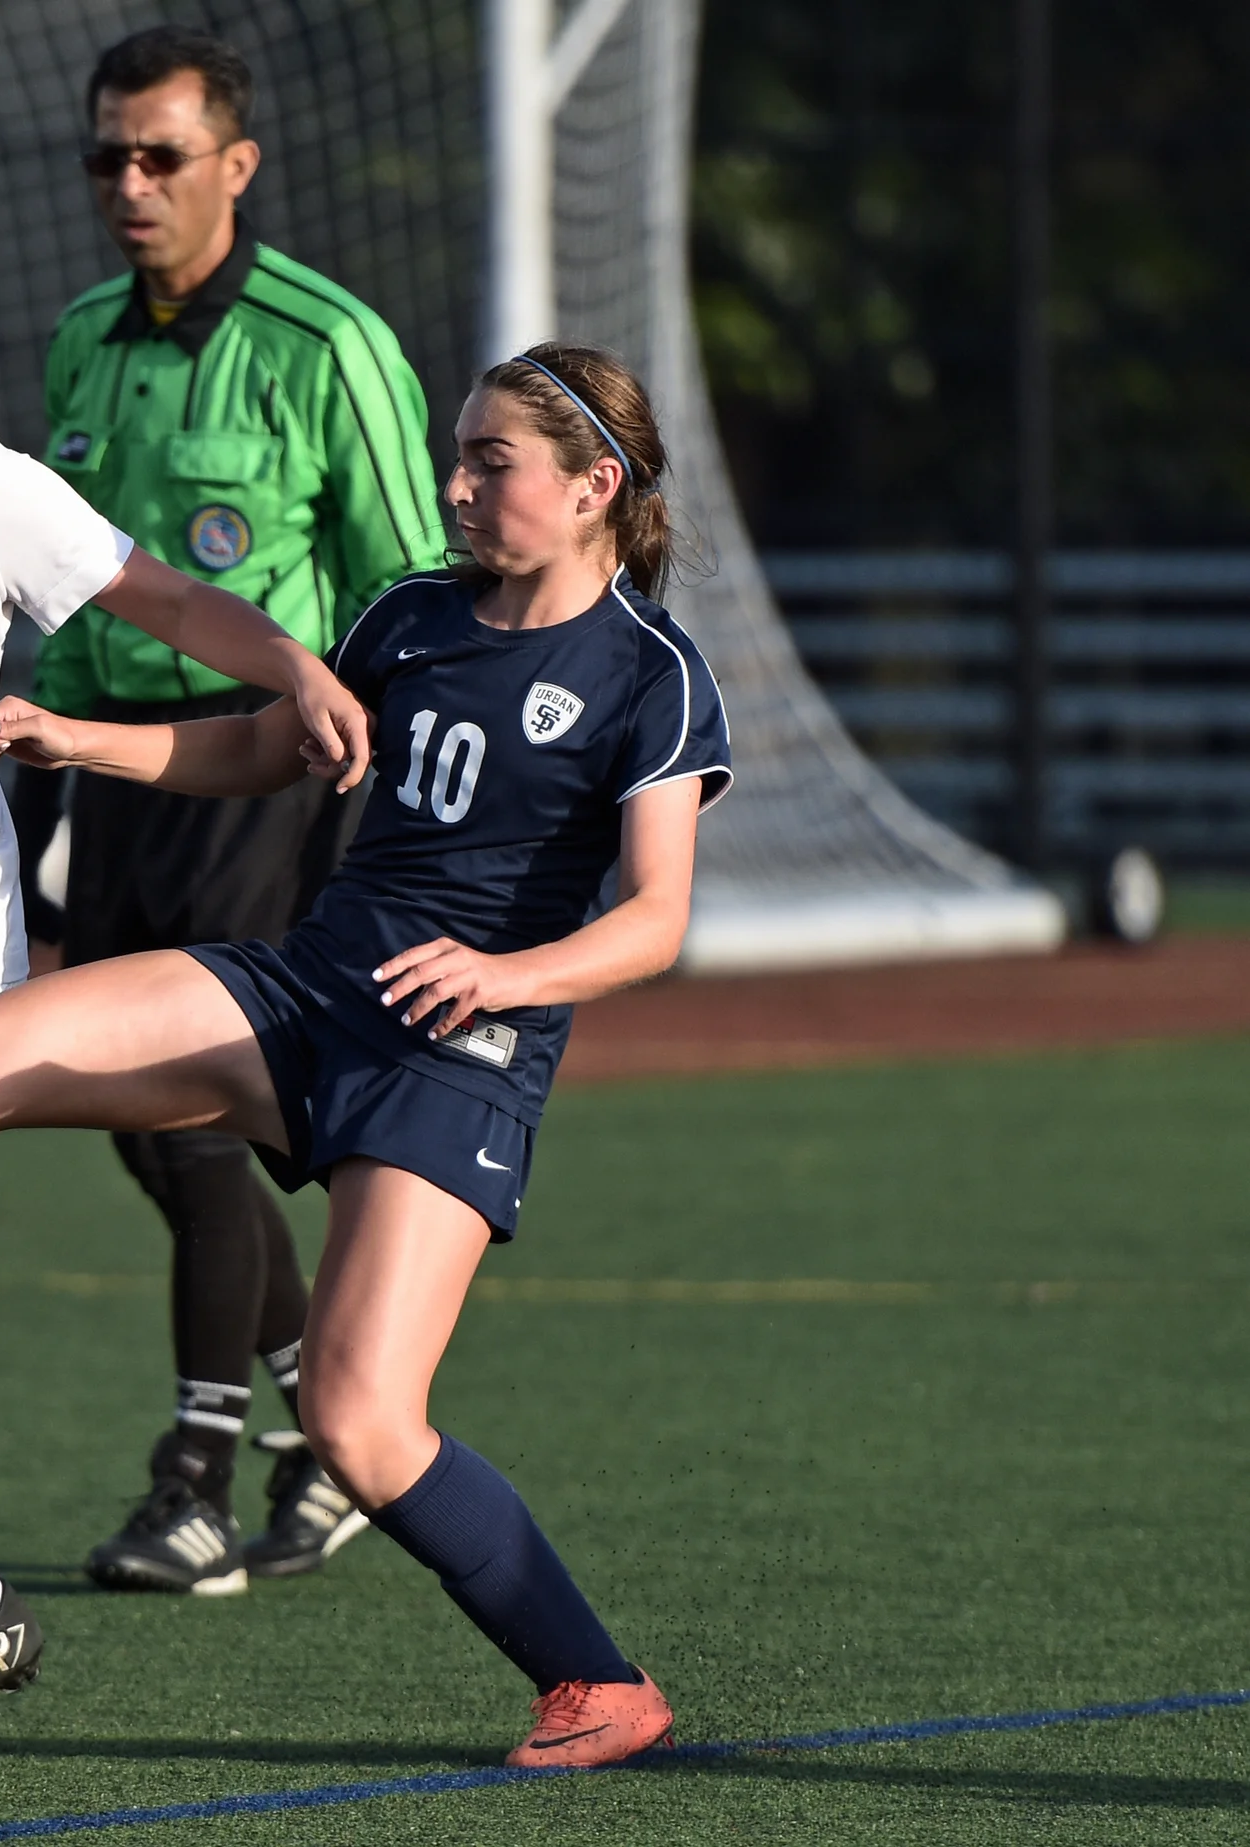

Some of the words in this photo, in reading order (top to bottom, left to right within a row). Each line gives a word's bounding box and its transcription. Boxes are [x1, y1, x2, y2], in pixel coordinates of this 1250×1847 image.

[535, 688, 576, 714] URBAN
[397, 709, 487, 824] 10
[484, 1027, 496, 1040] S
